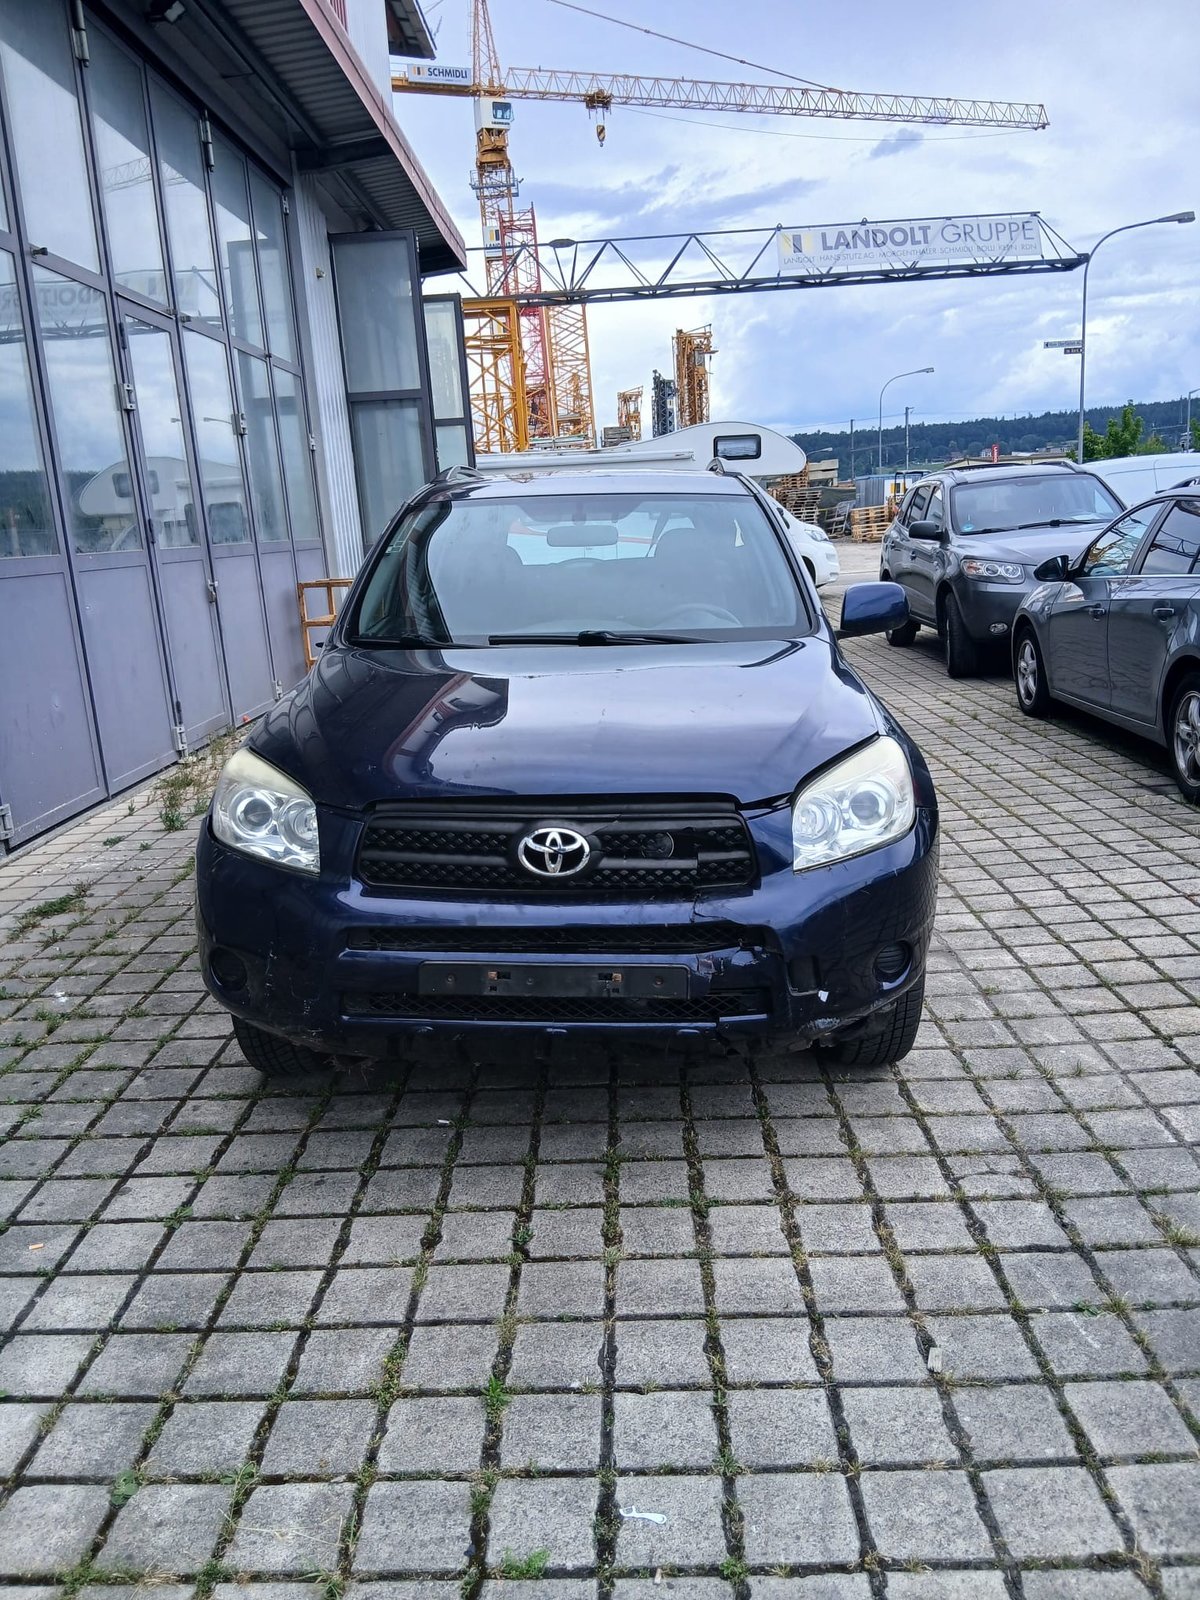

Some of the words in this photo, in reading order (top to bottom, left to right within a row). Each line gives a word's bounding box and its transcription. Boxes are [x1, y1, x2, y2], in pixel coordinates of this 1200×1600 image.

[427, 67, 468, 79] SCHMIDLI
[821, 226, 931, 251] LANDOLT
[941, 220, 1035, 243] GRUPPE
